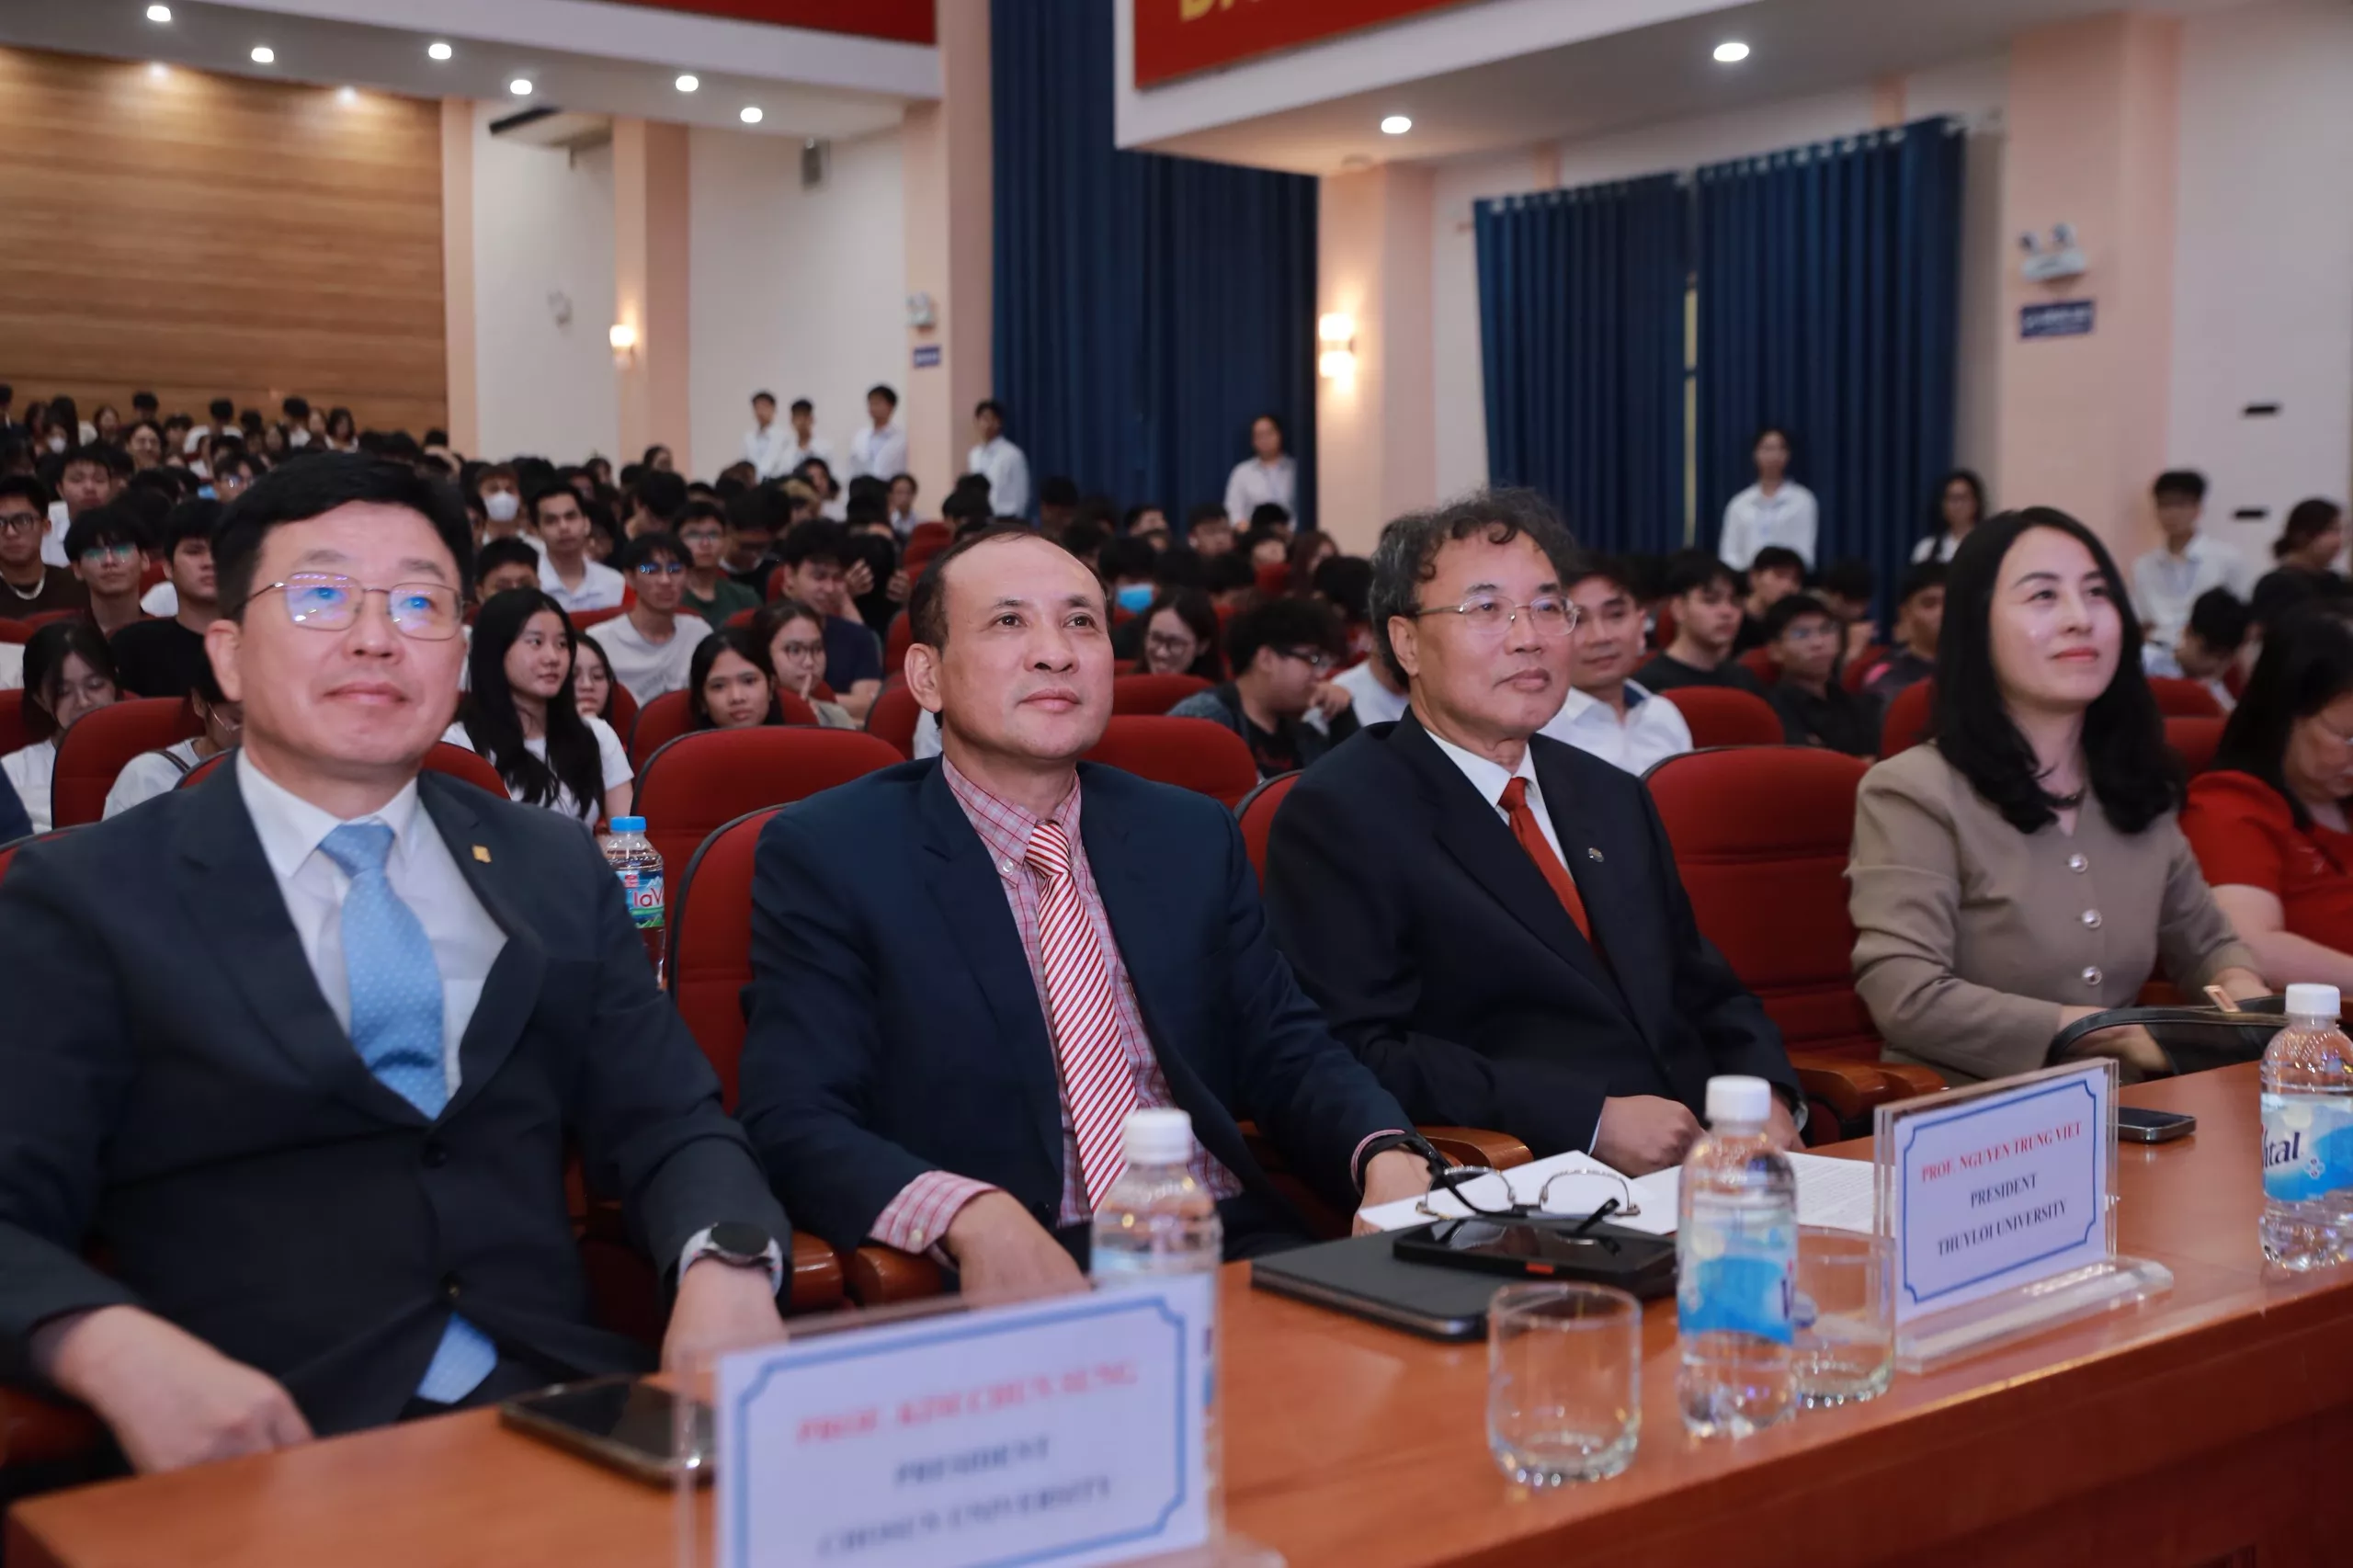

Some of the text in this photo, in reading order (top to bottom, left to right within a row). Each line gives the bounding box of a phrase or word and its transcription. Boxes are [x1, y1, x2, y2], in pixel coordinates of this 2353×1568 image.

[1960, 1144, 2010, 1169] NGUYEN
[2013, 1131, 2052, 1154] TRUNG
[2055, 1121, 2082, 1142] VIET
[1970, 1173, 2038, 1209] PRESIDENT
[1996, 1199, 2067, 1233] UNIVERSITY
